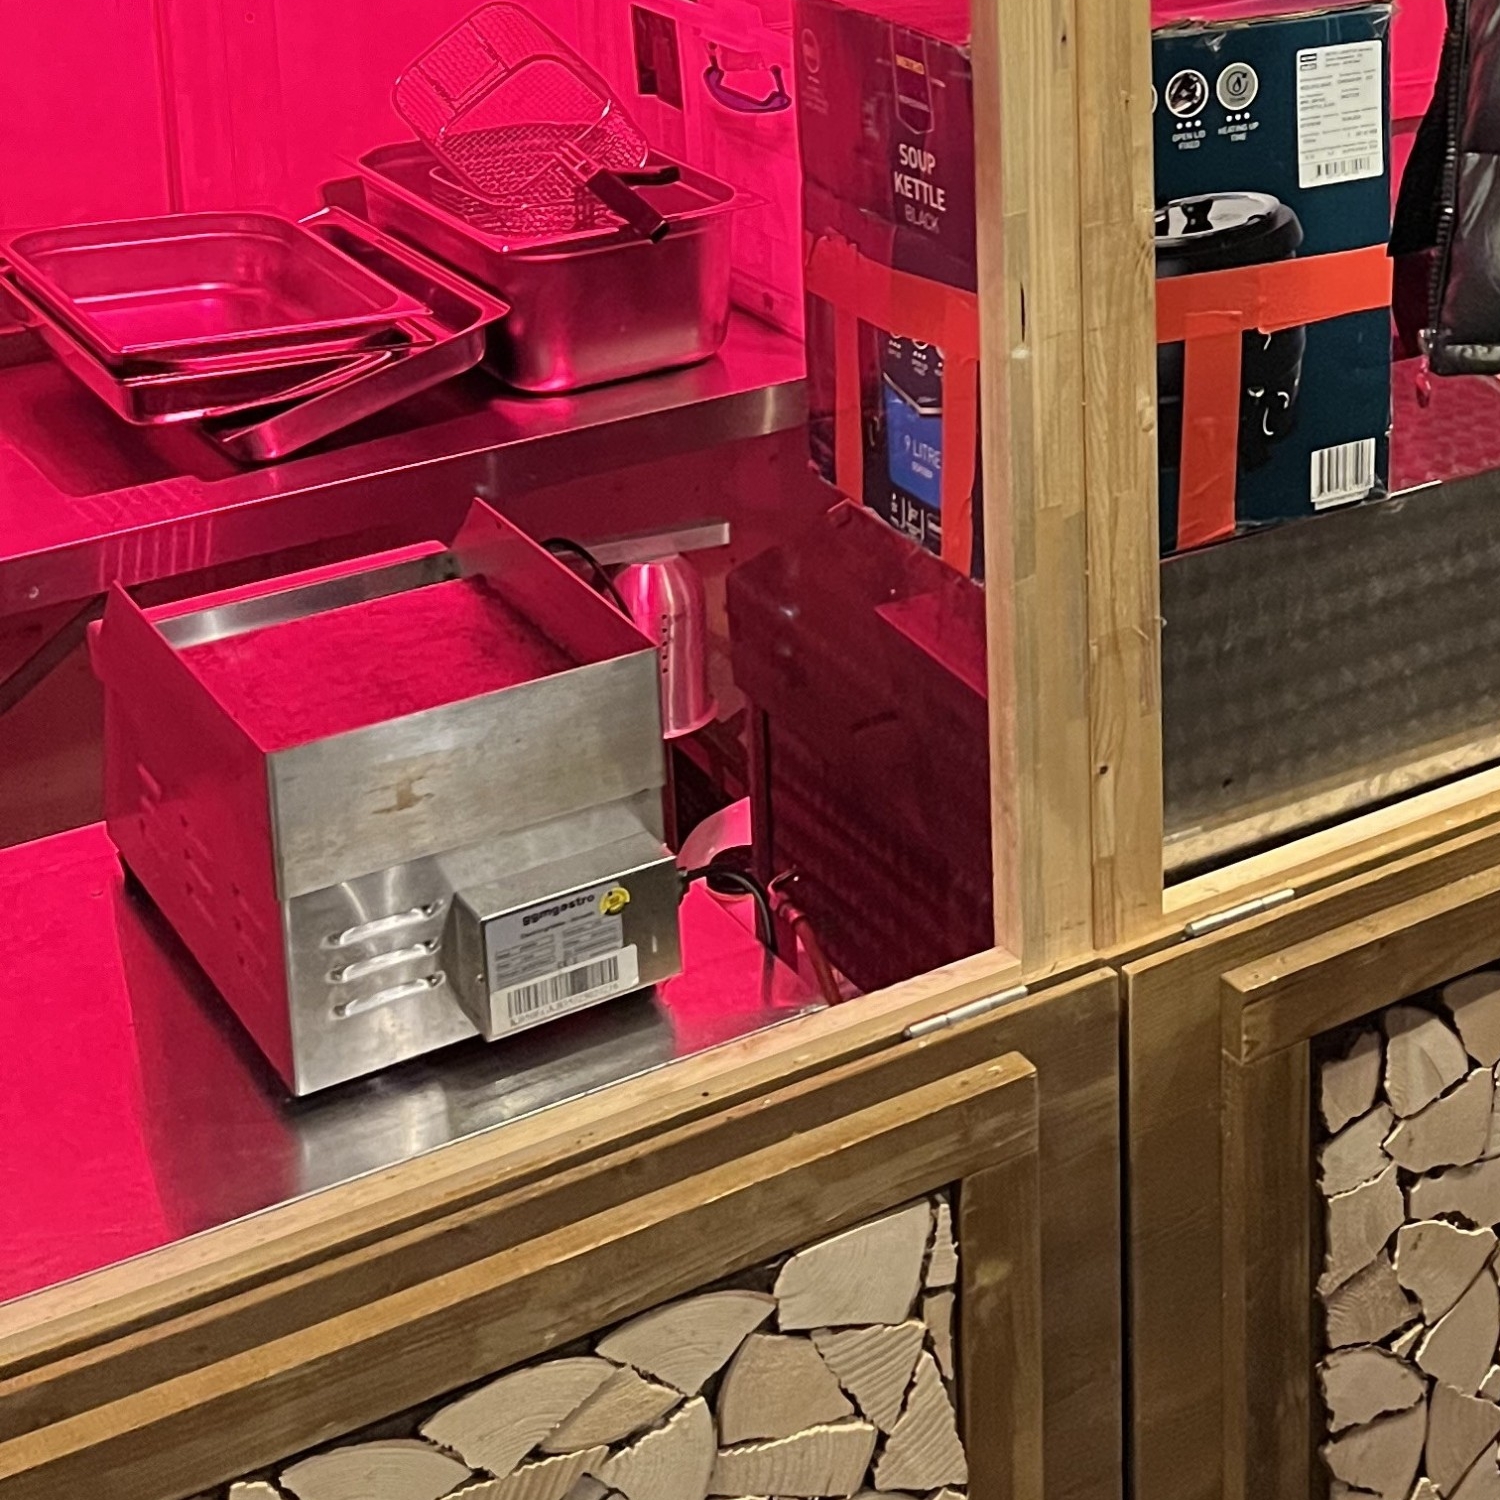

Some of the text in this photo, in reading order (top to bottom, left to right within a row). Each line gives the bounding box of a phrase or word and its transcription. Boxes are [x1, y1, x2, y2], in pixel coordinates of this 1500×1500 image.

[899, 143, 936, 175] SOUP
[894, 171, 946, 212] KETTLE
[905, 203, 940, 234] BLACK
